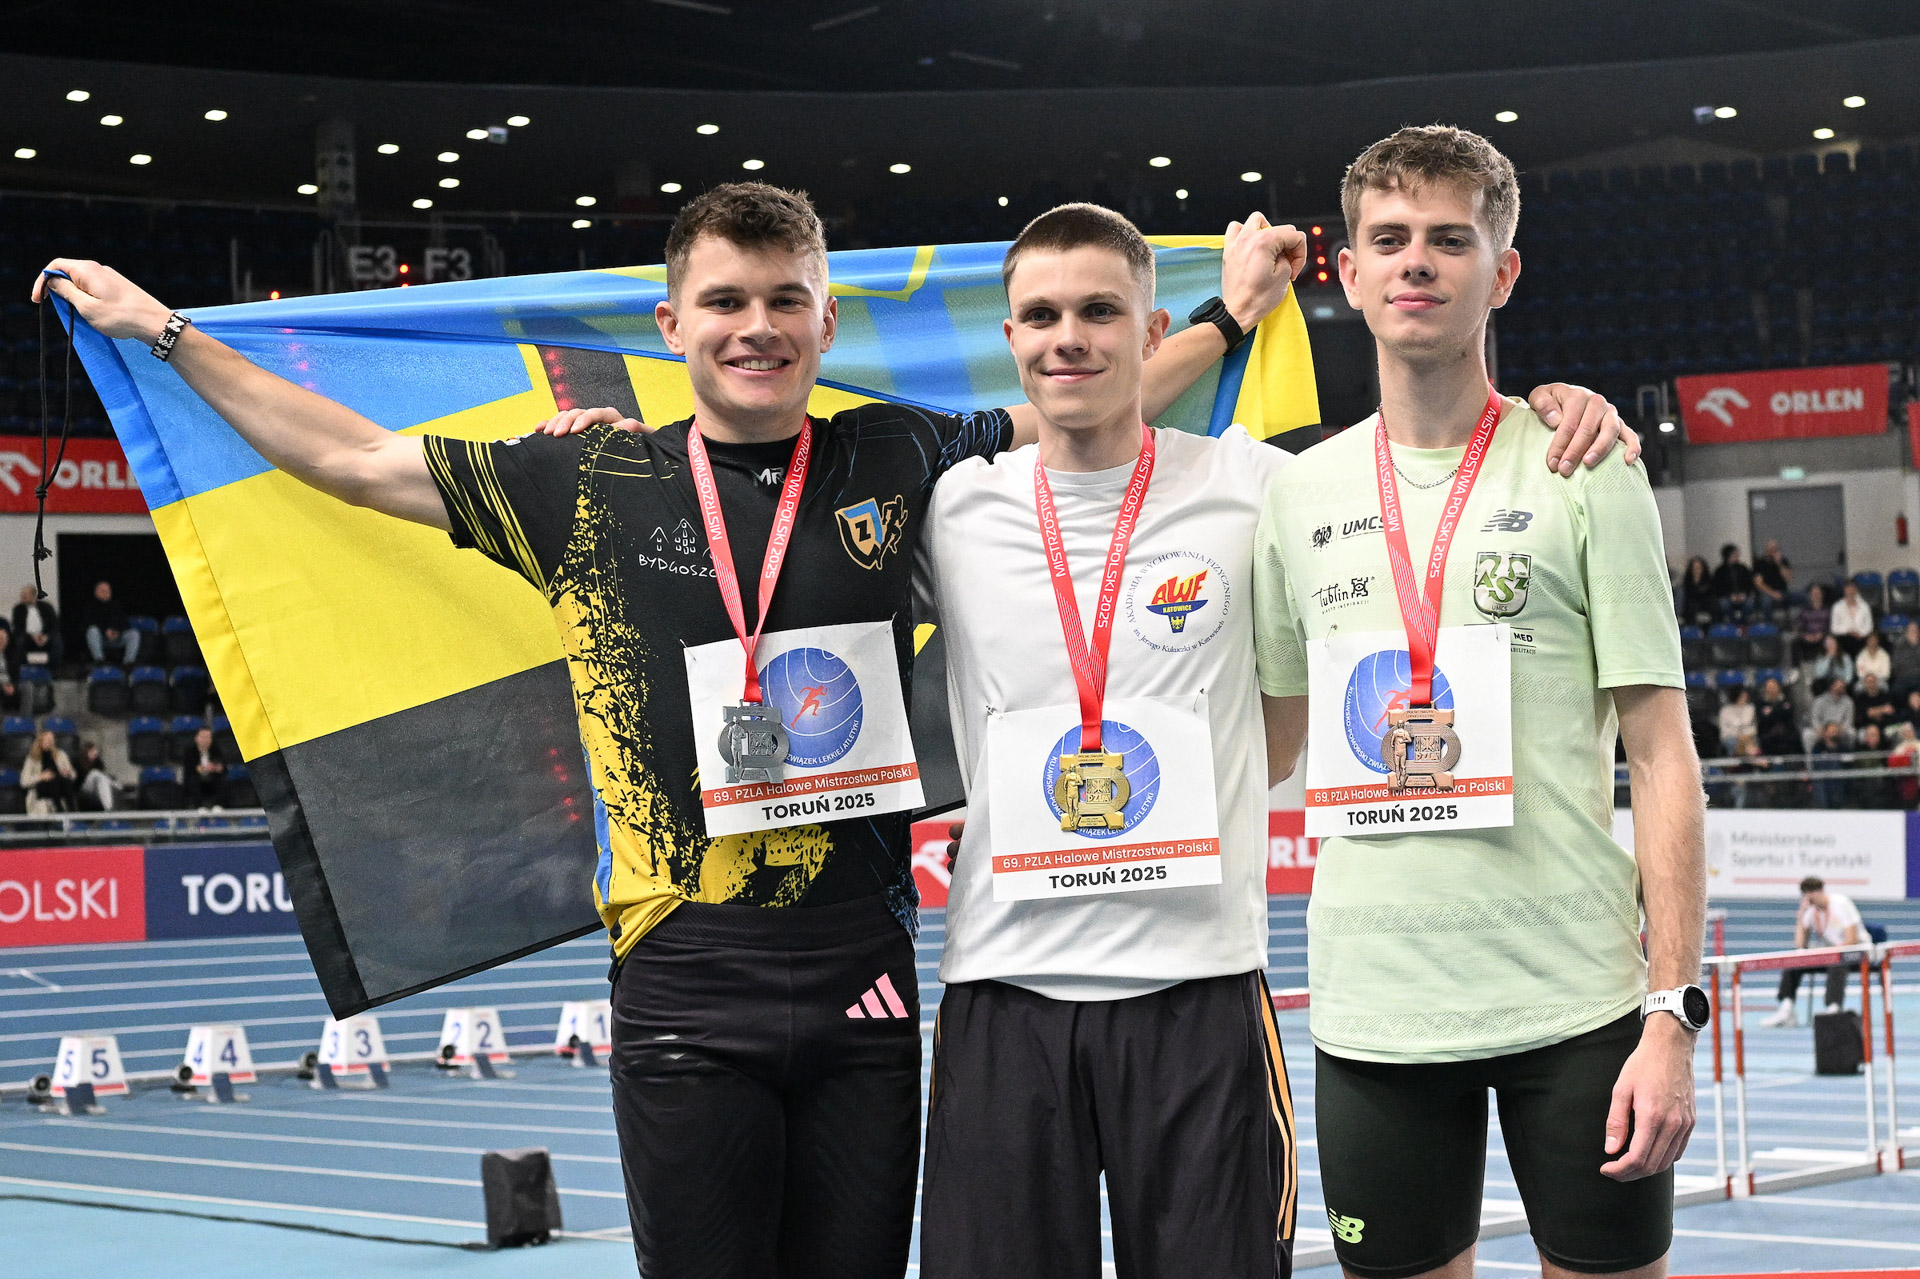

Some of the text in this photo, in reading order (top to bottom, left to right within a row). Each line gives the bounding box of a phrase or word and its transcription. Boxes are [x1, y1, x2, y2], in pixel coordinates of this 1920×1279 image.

[349, 245, 397, 280] E3
[424, 247, 470, 281] F3
[1770, 387, 1865, 416] ORLEN
[694, 455, 723, 541] MISTRZOSTWA
[1377, 450, 1400, 533] MISTRZOSTWA
[1430, 406, 1497, 578] MISTRZOSTWA POLSKI 2025
[773, 500, 795, 545] POLSKI
[1038, 487, 1066, 578] MISTRZOSTWA
[1098, 450, 1152, 628] MISTRZOSTWA POLSKI 2025
[765, 548, 782, 579] 2025
[1125, 550, 1231, 623] AKADEMIA WYCHOWANIA FIZYCZNEGO
[1150, 568, 1209, 605] AWF
[1163, 605, 1192, 613] KATOWICE
[1491, 603, 1508, 612] UMCS
[1513, 632, 1533, 643] MED
[818, 747, 844, 764] LEKKIEJ
[843, 719, 860, 750] ATLETYKI
[713, 766, 912, 803] 69. PZLA Halowe Mistrzostwa Polski
[1315, 791, 1330, 803] 69.
[1331, 791, 1350, 802] PZLA
[1351, 787, 1389, 800] Halowe
[1470, 780, 1506, 793] Polski
[762, 793, 875, 821] TORUŃ 2025
[1134, 792, 1155, 823] ATLETYKI
[1348, 804, 1458, 826] TORUŃ 2025
[1730, 831, 1836, 847] Ministerstwo
[1003, 841, 1213, 869] 69. PZLA Halowe Mistrzostwa Polski
[1731, 853, 1784, 868] Sportu
[1798, 853, 1872, 868] Turystyki
[1049, 865, 1167, 889] TORUŃ 2025
[476, 1021, 492, 1048] 2
[595, 1014, 607, 1039] 1
[220, 1038, 238, 1067] 4
[328, 1030, 339, 1059] 3
[355, 1029, 372, 1058] 3
[62, 1050, 74, 1080] 5
[91, 1049, 110, 1079] 5
